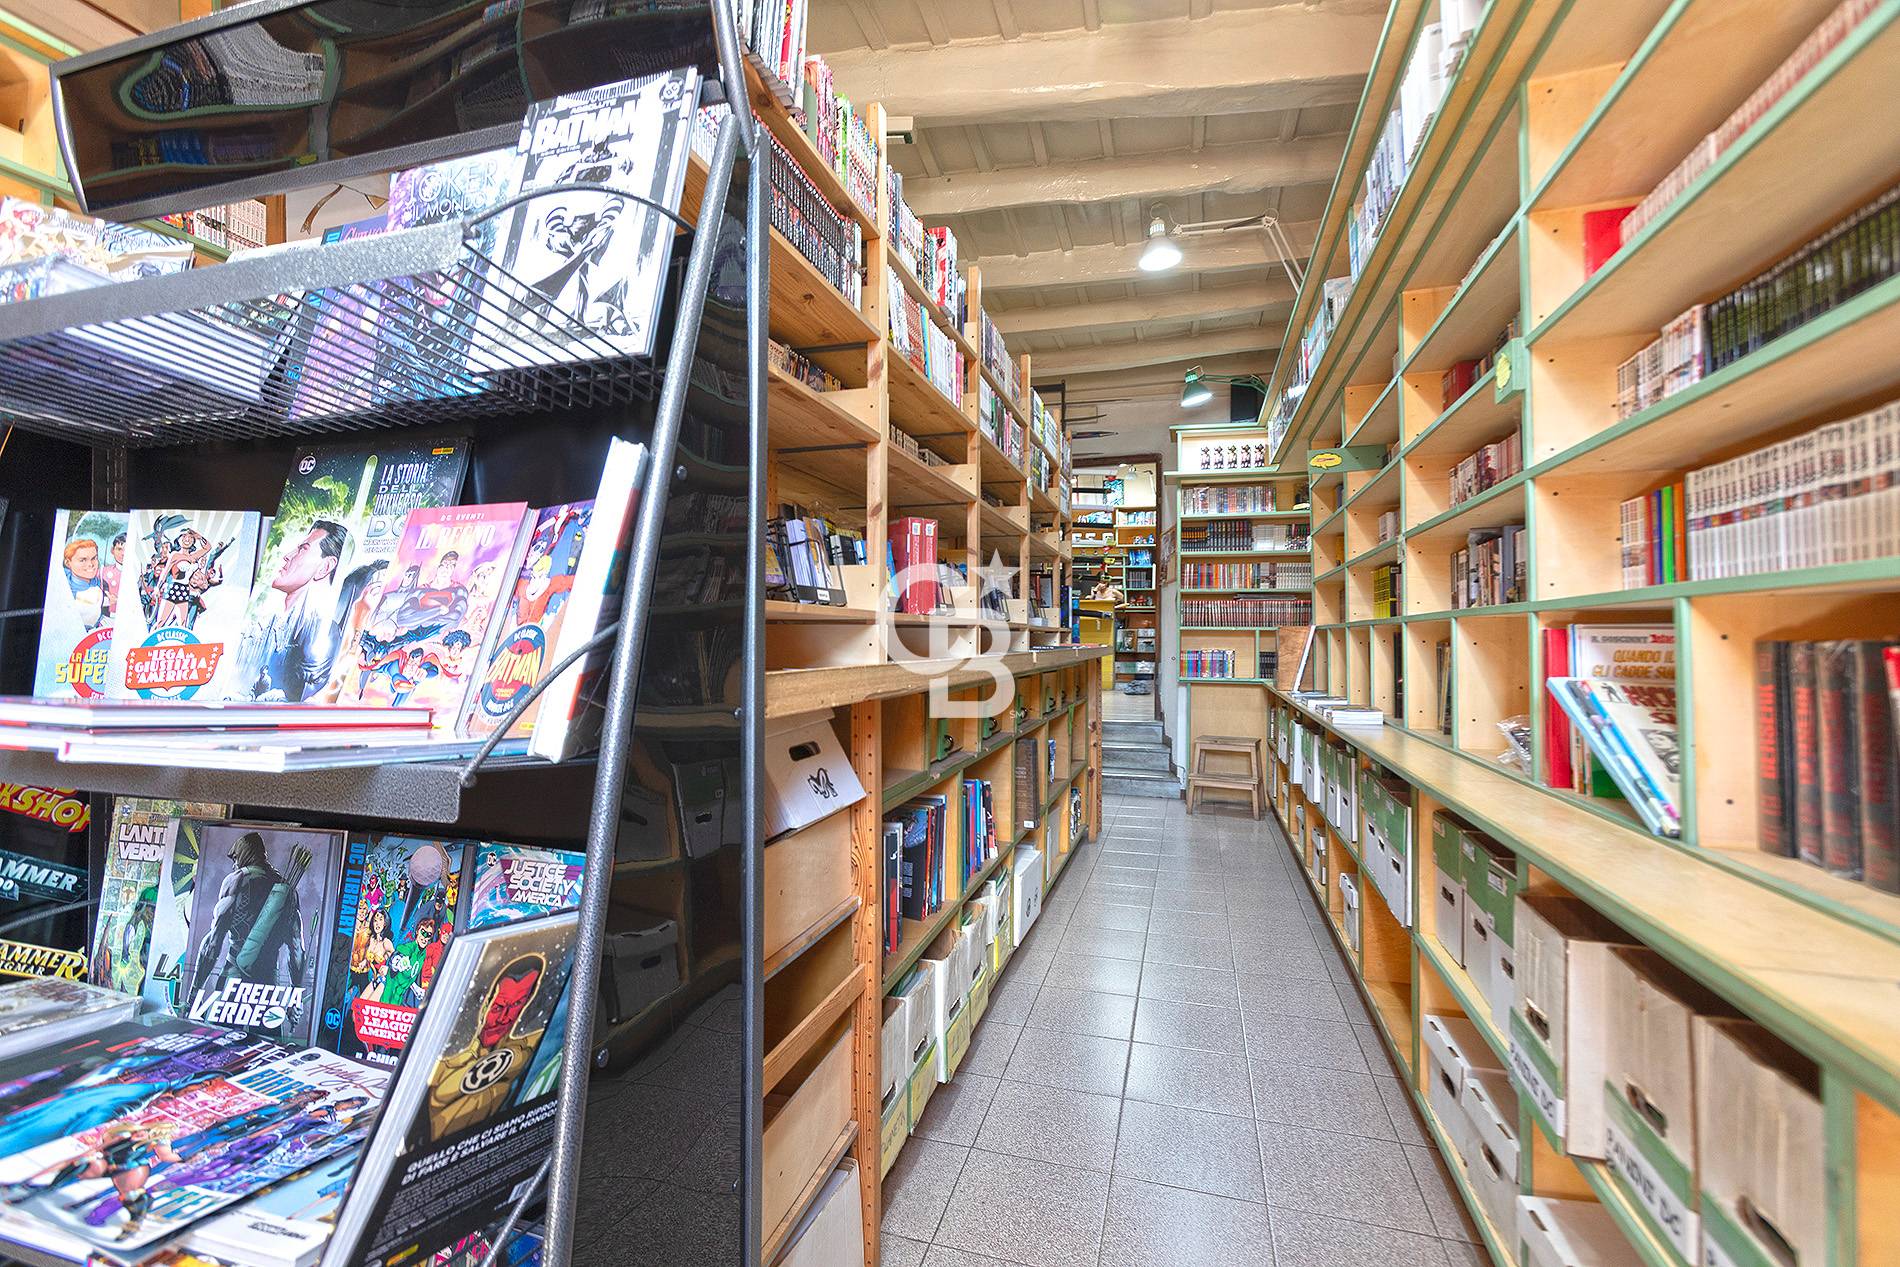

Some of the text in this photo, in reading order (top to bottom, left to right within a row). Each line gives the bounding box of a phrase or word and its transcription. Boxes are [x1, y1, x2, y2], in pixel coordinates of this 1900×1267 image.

[406, 159, 498, 204] JOKER
[425, 193, 487, 219] MONDO
[300, 456, 316, 474] DC
[381, 463, 428, 485] LA STORIA
[134, 657, 208, 674] GIUSTIZIA
[152, 648, 186, 661] LEGA
[504, 860, 568, 880] JUSTICE
[338, 843, 367, 938] DC LIBRARY
[508, 873, 576, 896] SOCIETY
[511, 889, 563, 907] AMERICA
[221, 977, 305, 1008] FRECCIA
[188, 989, 264, 1028] VERDE
[326, 1011, 340, 1025] DC
[407, 1144, 457, 1174] QUELLO
[457, 1134, 481, 1150] CHE
[481, 1128, 493, 1141] CI
[493, 1113, 526, 1135] SIAMO
[401, 1171, 416, 1187] DI
[417, 1157, 450, 1181] FARE
[460, 1130, 509, 1160] SALVARE
